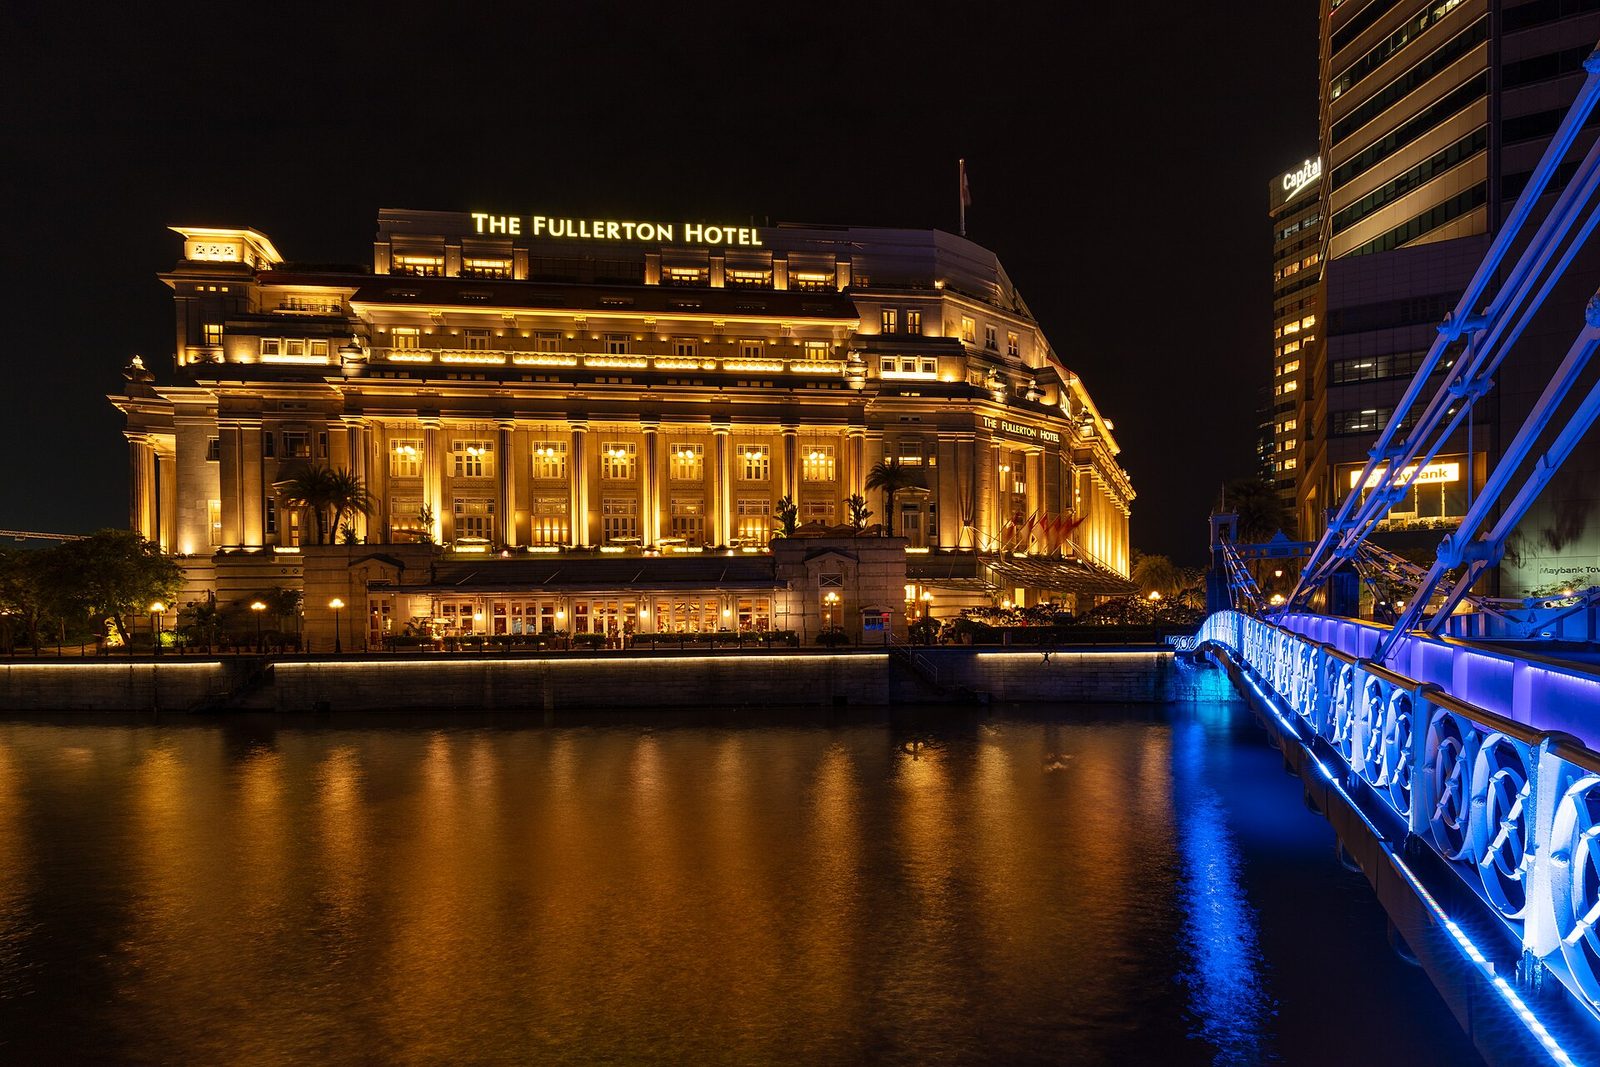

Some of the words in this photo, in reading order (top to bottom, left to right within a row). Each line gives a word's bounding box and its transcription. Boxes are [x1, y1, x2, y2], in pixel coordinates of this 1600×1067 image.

[1283, 156, 1321, 190] Capital
[471, 213, 521, 235] THE
[533, 216, 673, 241] FULLERTON
[684, 223, 763, 246] HOTEL
[983, 416, 997, 429] THE
[1002, 421, 1037, 437] FULLERTON
[1040, 429, 1060, 443] HOTEL
[1540, 566, 1584, 575] Maybank
